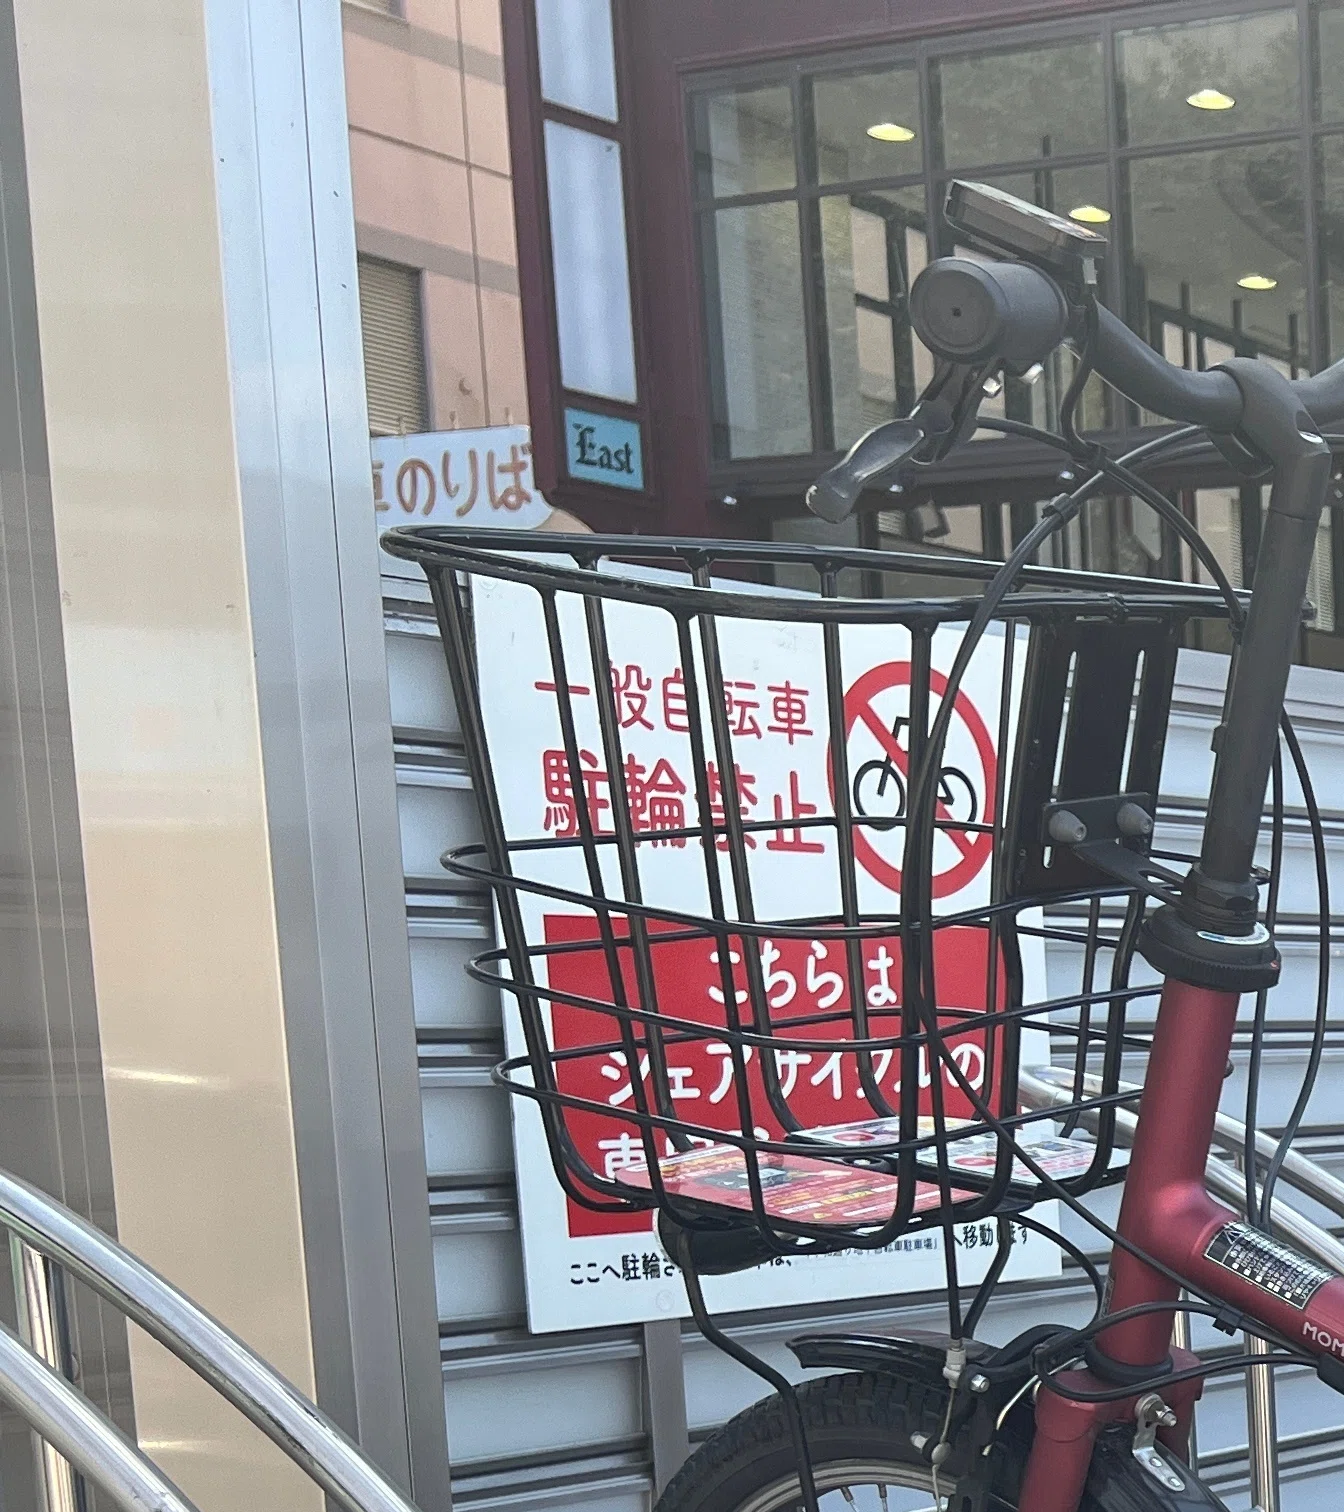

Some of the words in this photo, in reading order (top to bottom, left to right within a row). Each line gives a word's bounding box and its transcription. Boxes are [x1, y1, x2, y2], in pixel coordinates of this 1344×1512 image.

[572, 422, 635, 475] East
[534, 659, 813, 745] 一般自転車
[542, 749, 825, 854] 駐輪禁止
[707, 939, 898, 1010] こちらは
